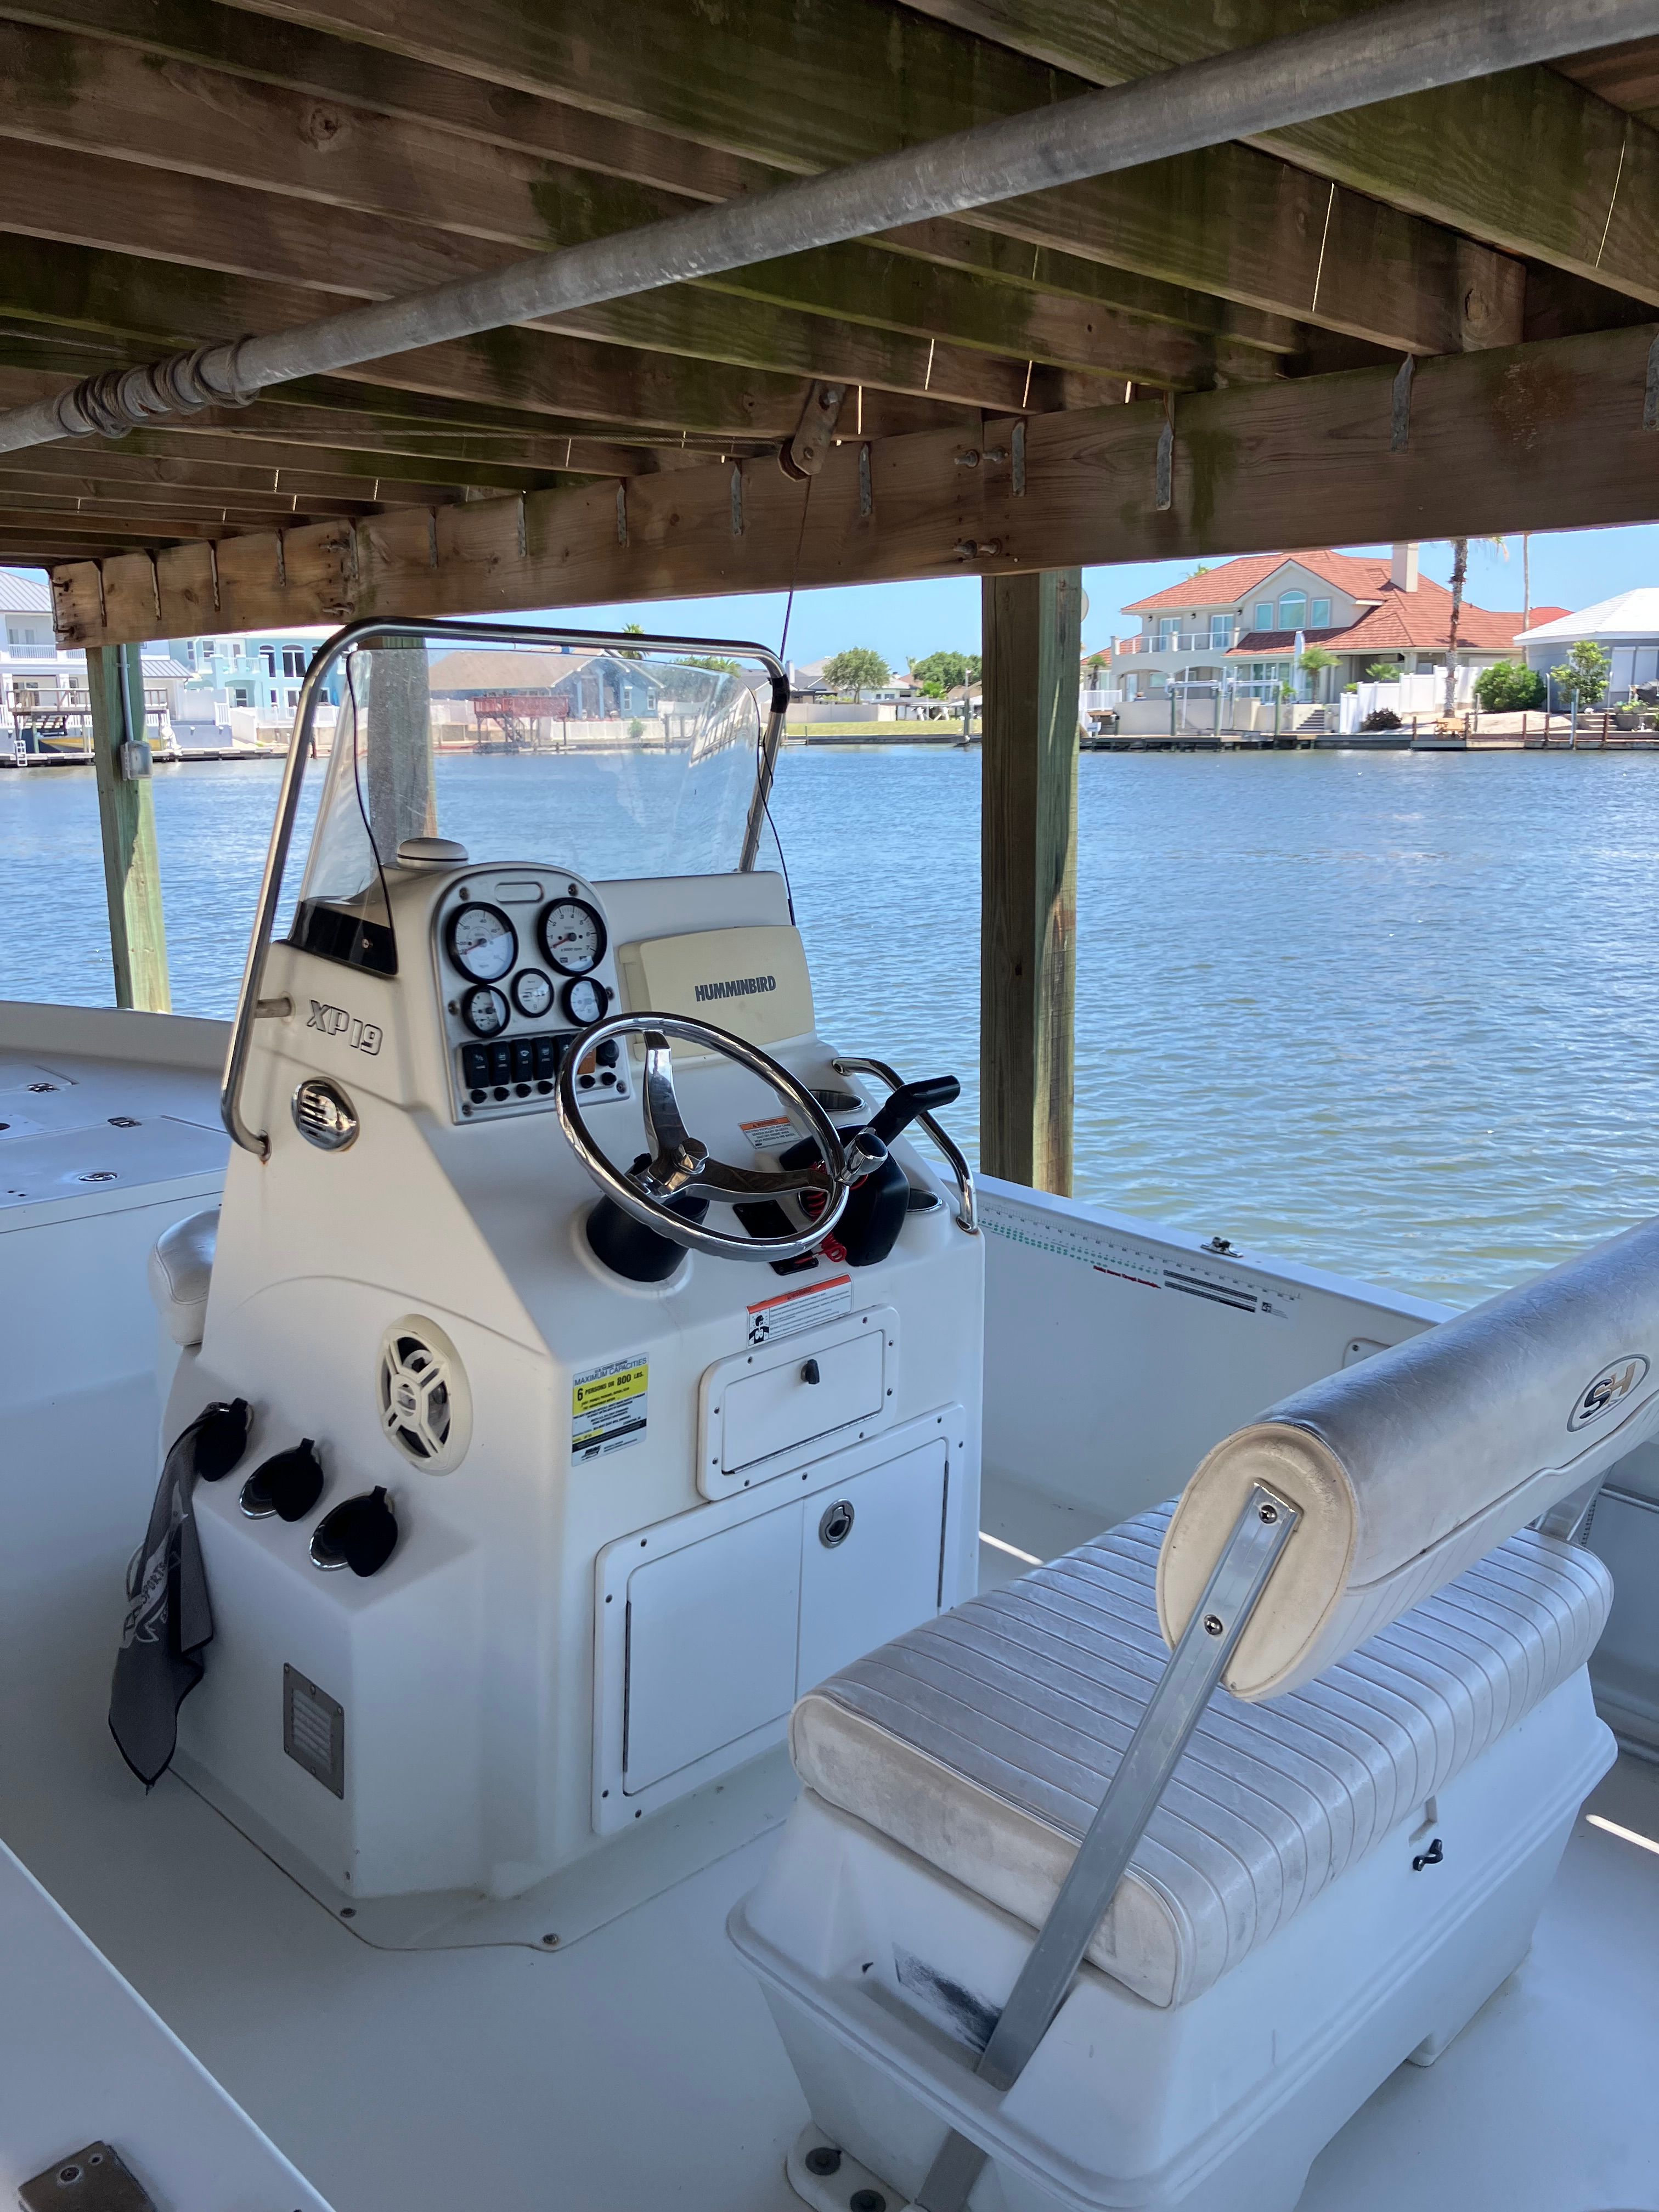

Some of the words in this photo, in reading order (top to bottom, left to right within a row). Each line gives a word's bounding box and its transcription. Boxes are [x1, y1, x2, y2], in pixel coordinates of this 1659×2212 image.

[695, 975, 776, 1002] HUMMINBIRD
[574, 1370, 608, 1386] MAXIMUM
[609, 1357, 647, 1375] CAPACITIES
[577, 1387, 583, 1401] 6
[585, 1383, 607, 1395] PERSONS
[617, 1374, 631, 1386] 800
